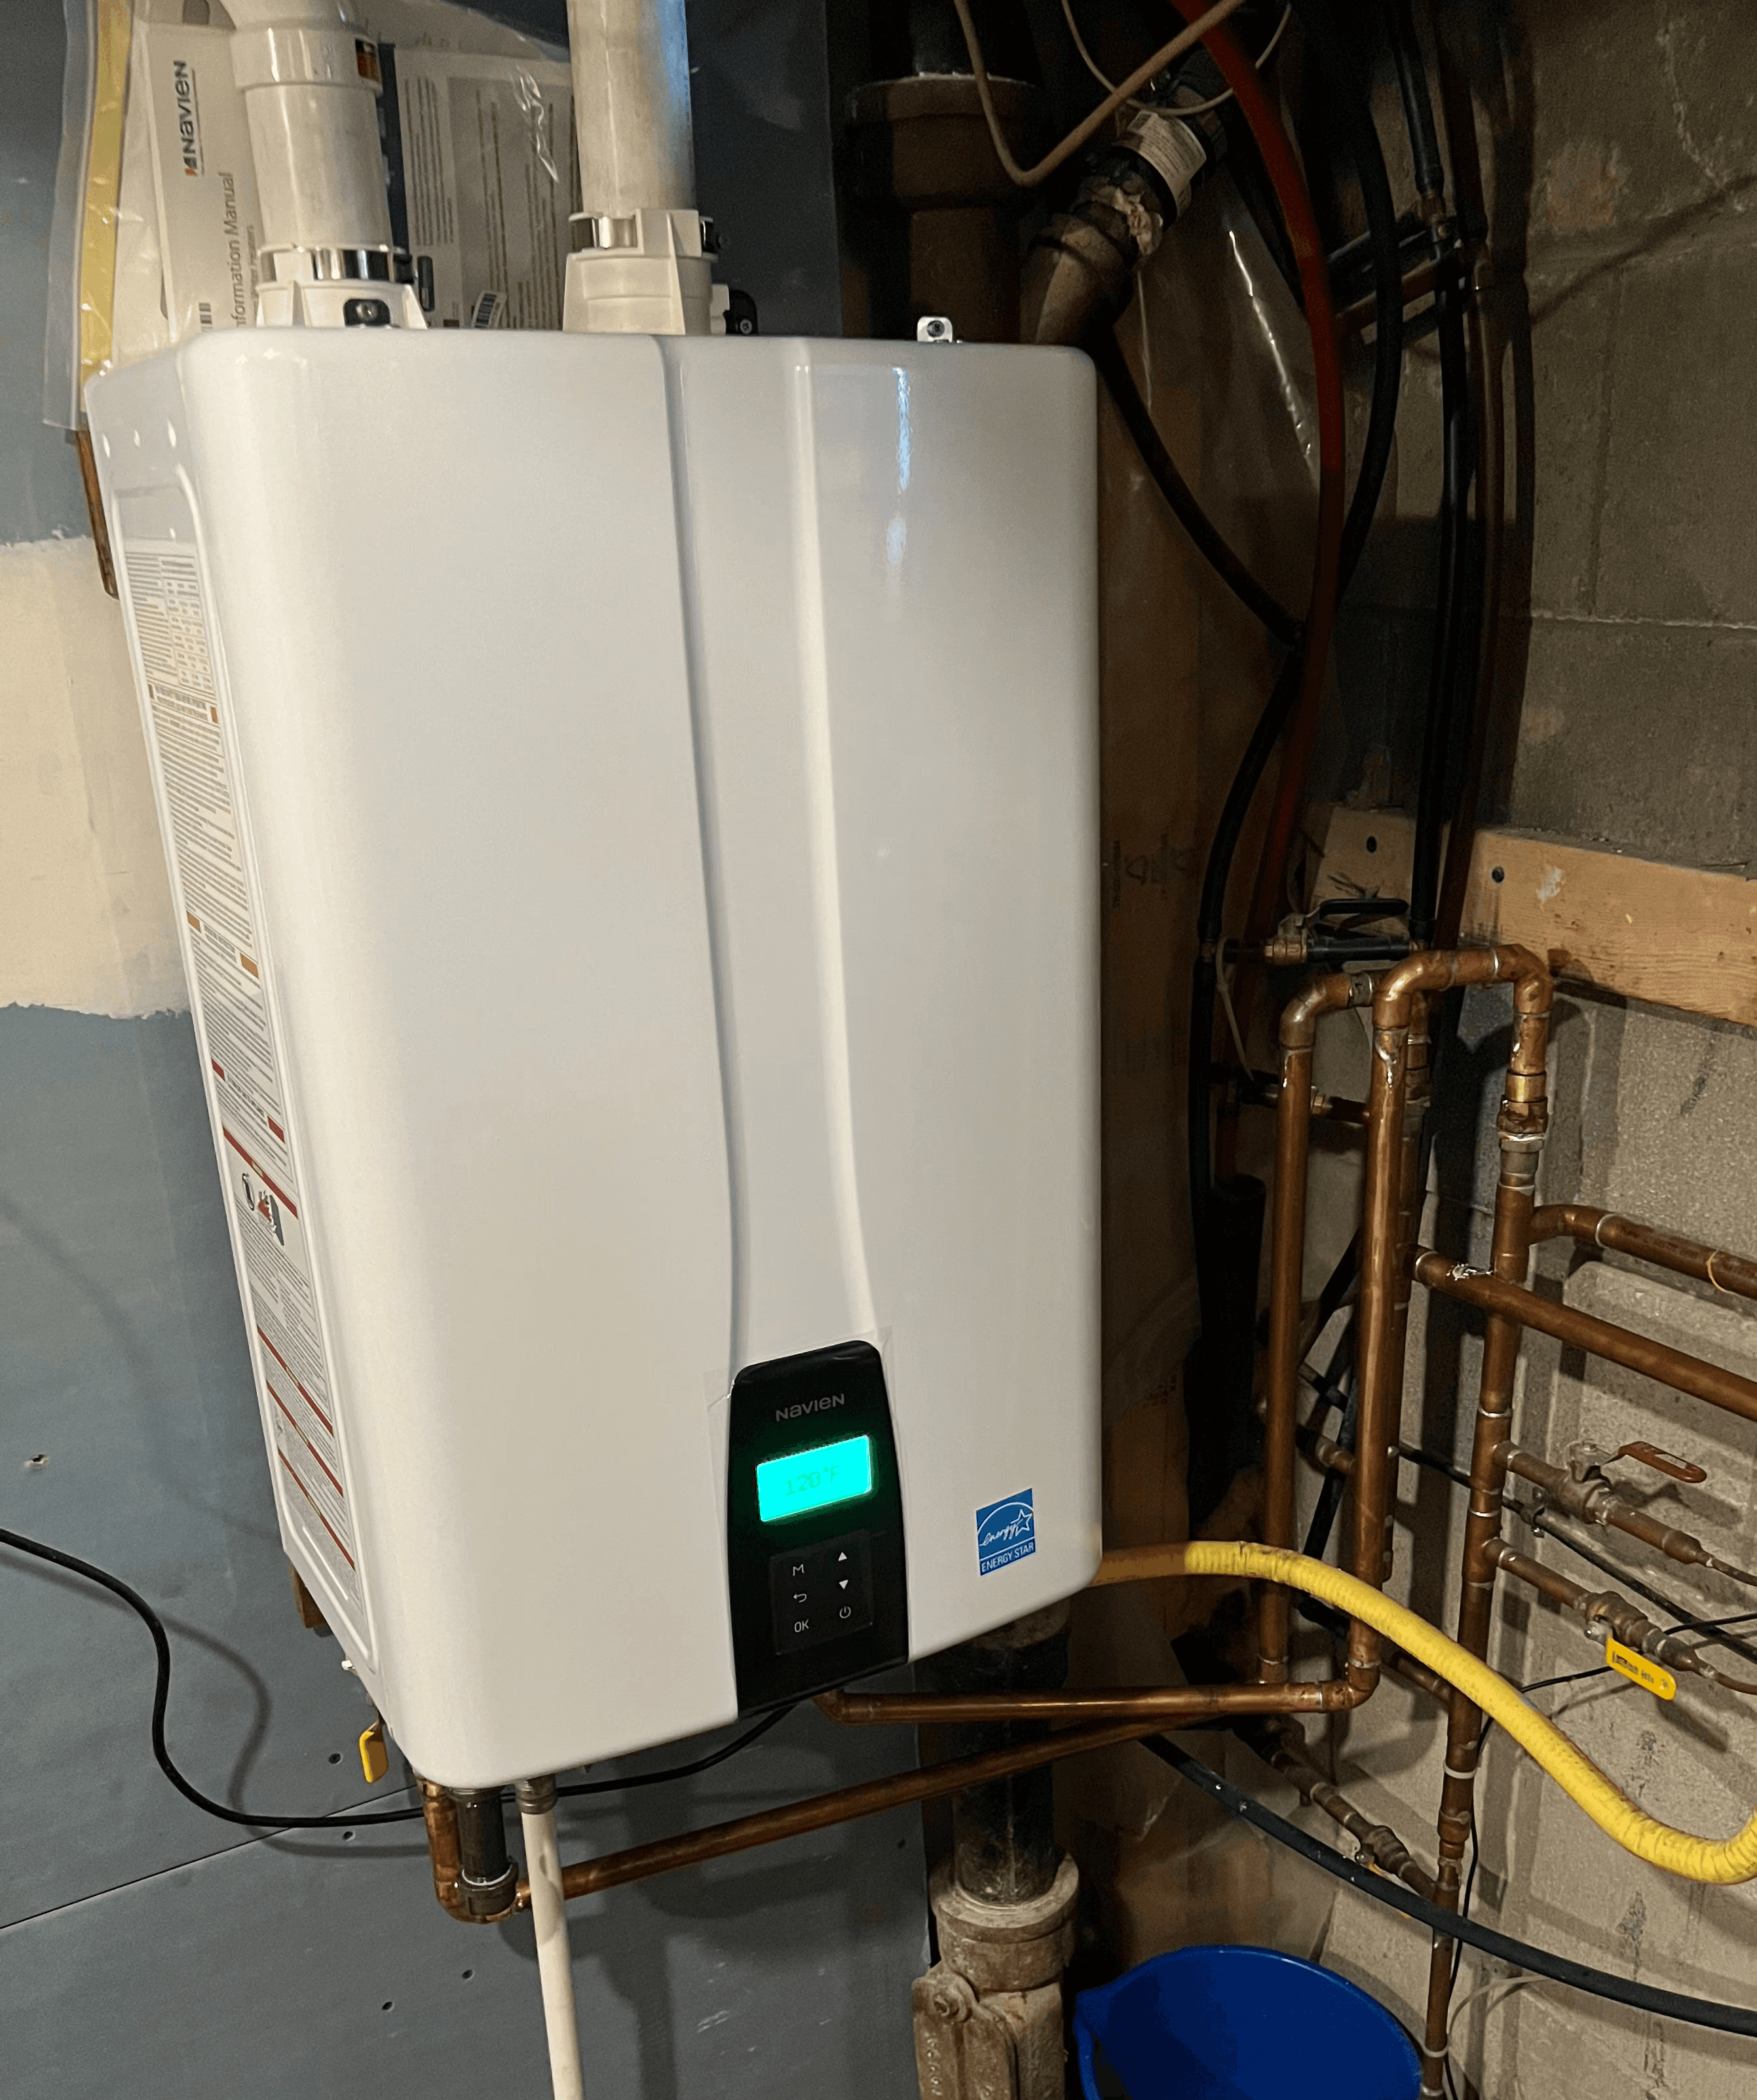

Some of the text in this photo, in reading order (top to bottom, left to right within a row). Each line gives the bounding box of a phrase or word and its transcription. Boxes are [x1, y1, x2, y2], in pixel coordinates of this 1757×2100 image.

[218, 172, 246, 328] nformation Manual
[785, 1465, 840, 1495] 120°F
[793, 1563, 804, 1576] M
[981, 1542, 1034, 1573] ENERGY STAR
[795, 1618, 809, 1633] OK
